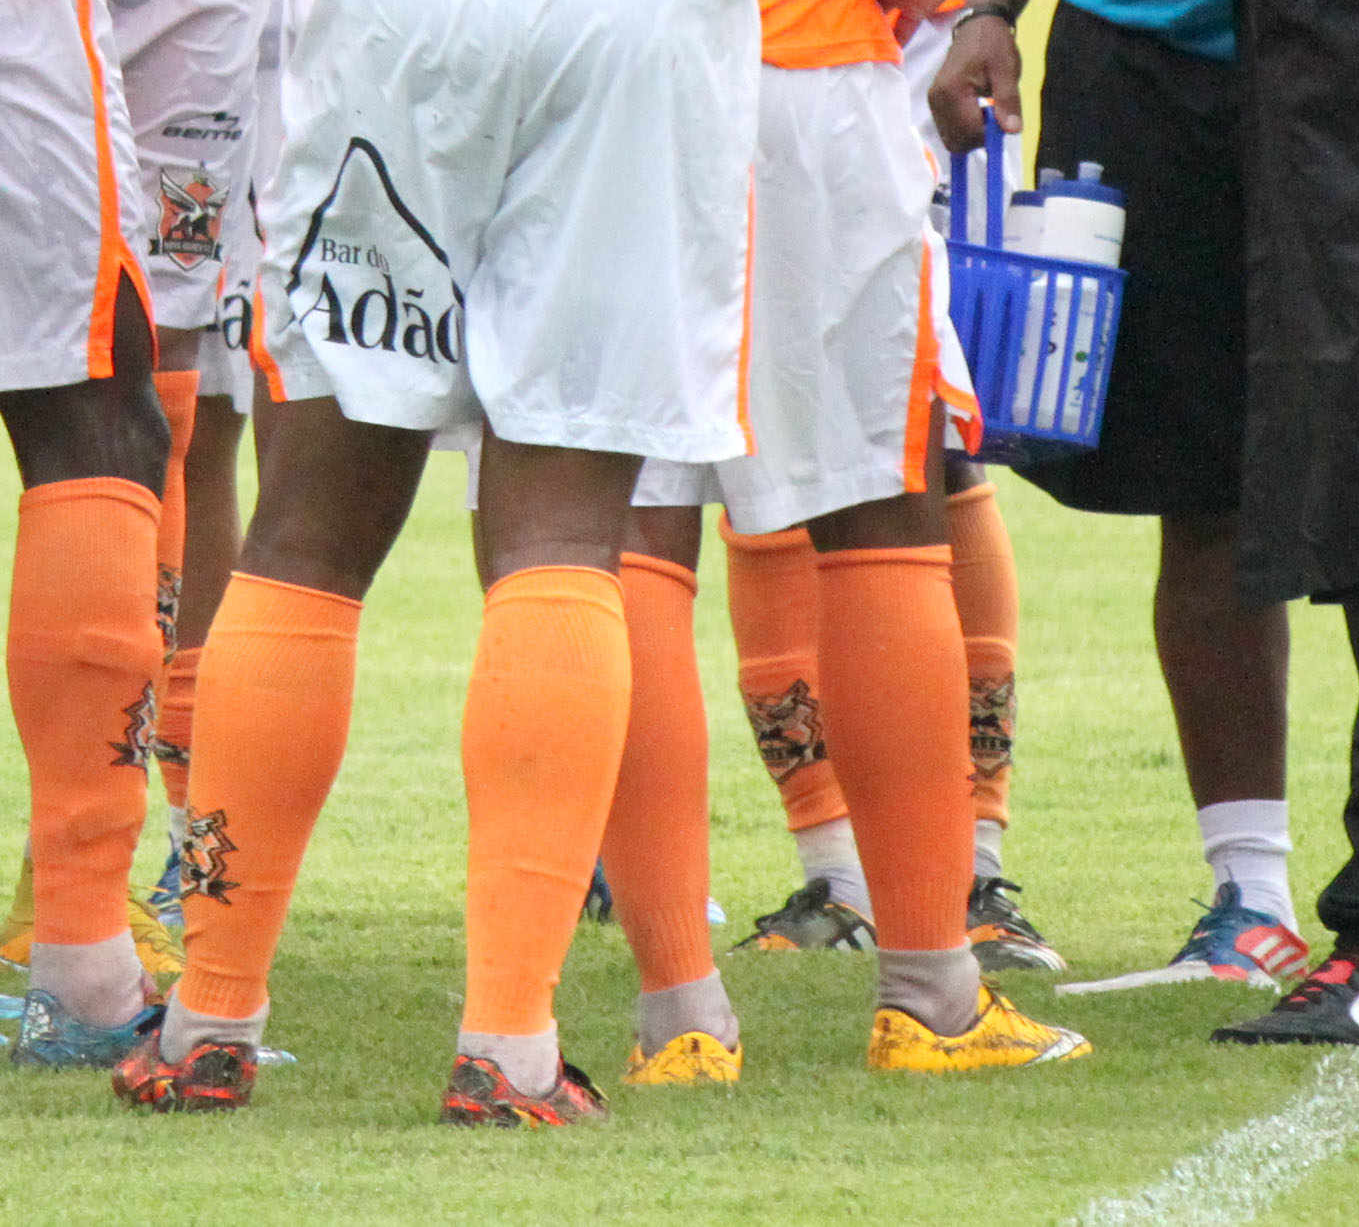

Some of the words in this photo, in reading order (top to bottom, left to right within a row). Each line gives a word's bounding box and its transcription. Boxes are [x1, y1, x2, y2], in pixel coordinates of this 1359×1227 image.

[321, 238, 362, 265] Bar
[366, 244, 390, 273] do
[280, 270, 463, 364] Adão
